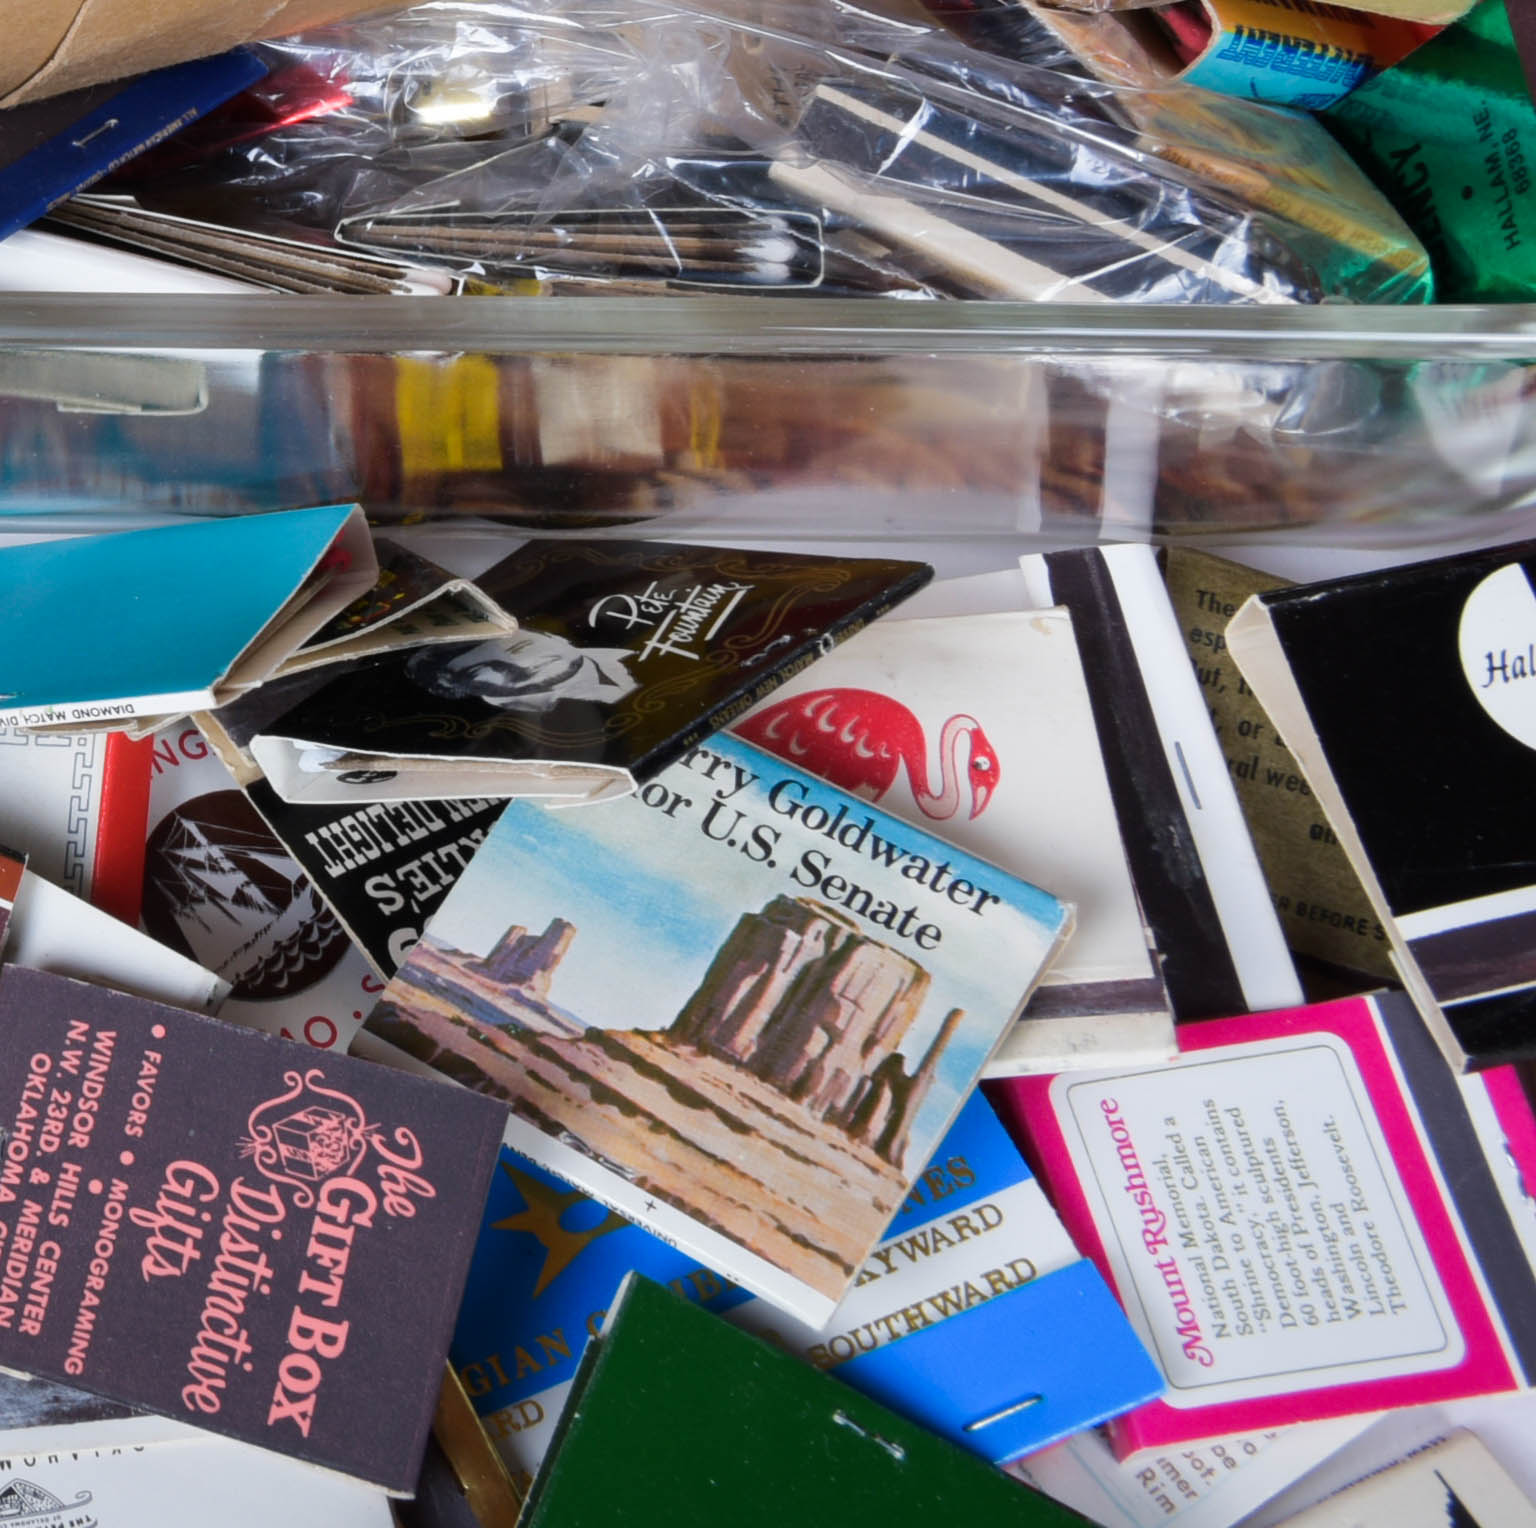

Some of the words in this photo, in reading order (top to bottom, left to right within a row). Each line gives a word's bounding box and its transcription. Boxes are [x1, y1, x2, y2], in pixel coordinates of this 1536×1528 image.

[589, 577, 675, 634] Pete
[639, 579, 752, 660] Fountain
[23, 711, 66, 723] MATCH
[71, 703, 135, 720] DIAMOND
[701, 798, 782, 869] U.S.
[789, 849, 942, 950] Senate
[768, 779, 1000, 914] Goldwater
[56, 1020, 89, 1078] N.W.
[63, 1025, 120, 1152] WINDSOR
[120, 1047, 165, 1141] FAVORS
[33, 1085, 74, 1163] 23RD.
[1165, 1133, 1198, 1191] Called
[1204, 1099, 1240, 1177] contains
[1223, 1107, 1275, 1204] sculptured
[44, 1158, 85, 1231] HILLS
[128, 1160, 220, 1282] Gifts
[370, 1127, 436, 1222] The
[1100, 1099, 1169, 1256] Rushmore
[1152, 1159, 1198, 1249] Memorial,
[1194, 1136, 1237, 1226] American
[1265, 1138, 1309, 1236] Presidents
[15, 1236, 66, 1340] CENTER
[58, 1176, 134, 1379] MONOGRAMING
[298, 1176, 377, 1307] GIFT
[1310, 1201, 1362, 1320] Washington,
[1349, 1243, 1386, 1316] Lincoln
[1364, 1222, 1406, 1315] Theodore
[181, 1176, 286, 1413] Distinctive
[806, 1256, 1038, 1368] SOUTHWARD
[1155, 1258, 1213, 1367] Mount
[1188, 1256, 1231, 1339] National
[1222, 1279, 1254, 1336] South
[1311, 1267, 1342, 1323] heads
[268, 1305, 349, 1437] BOX
